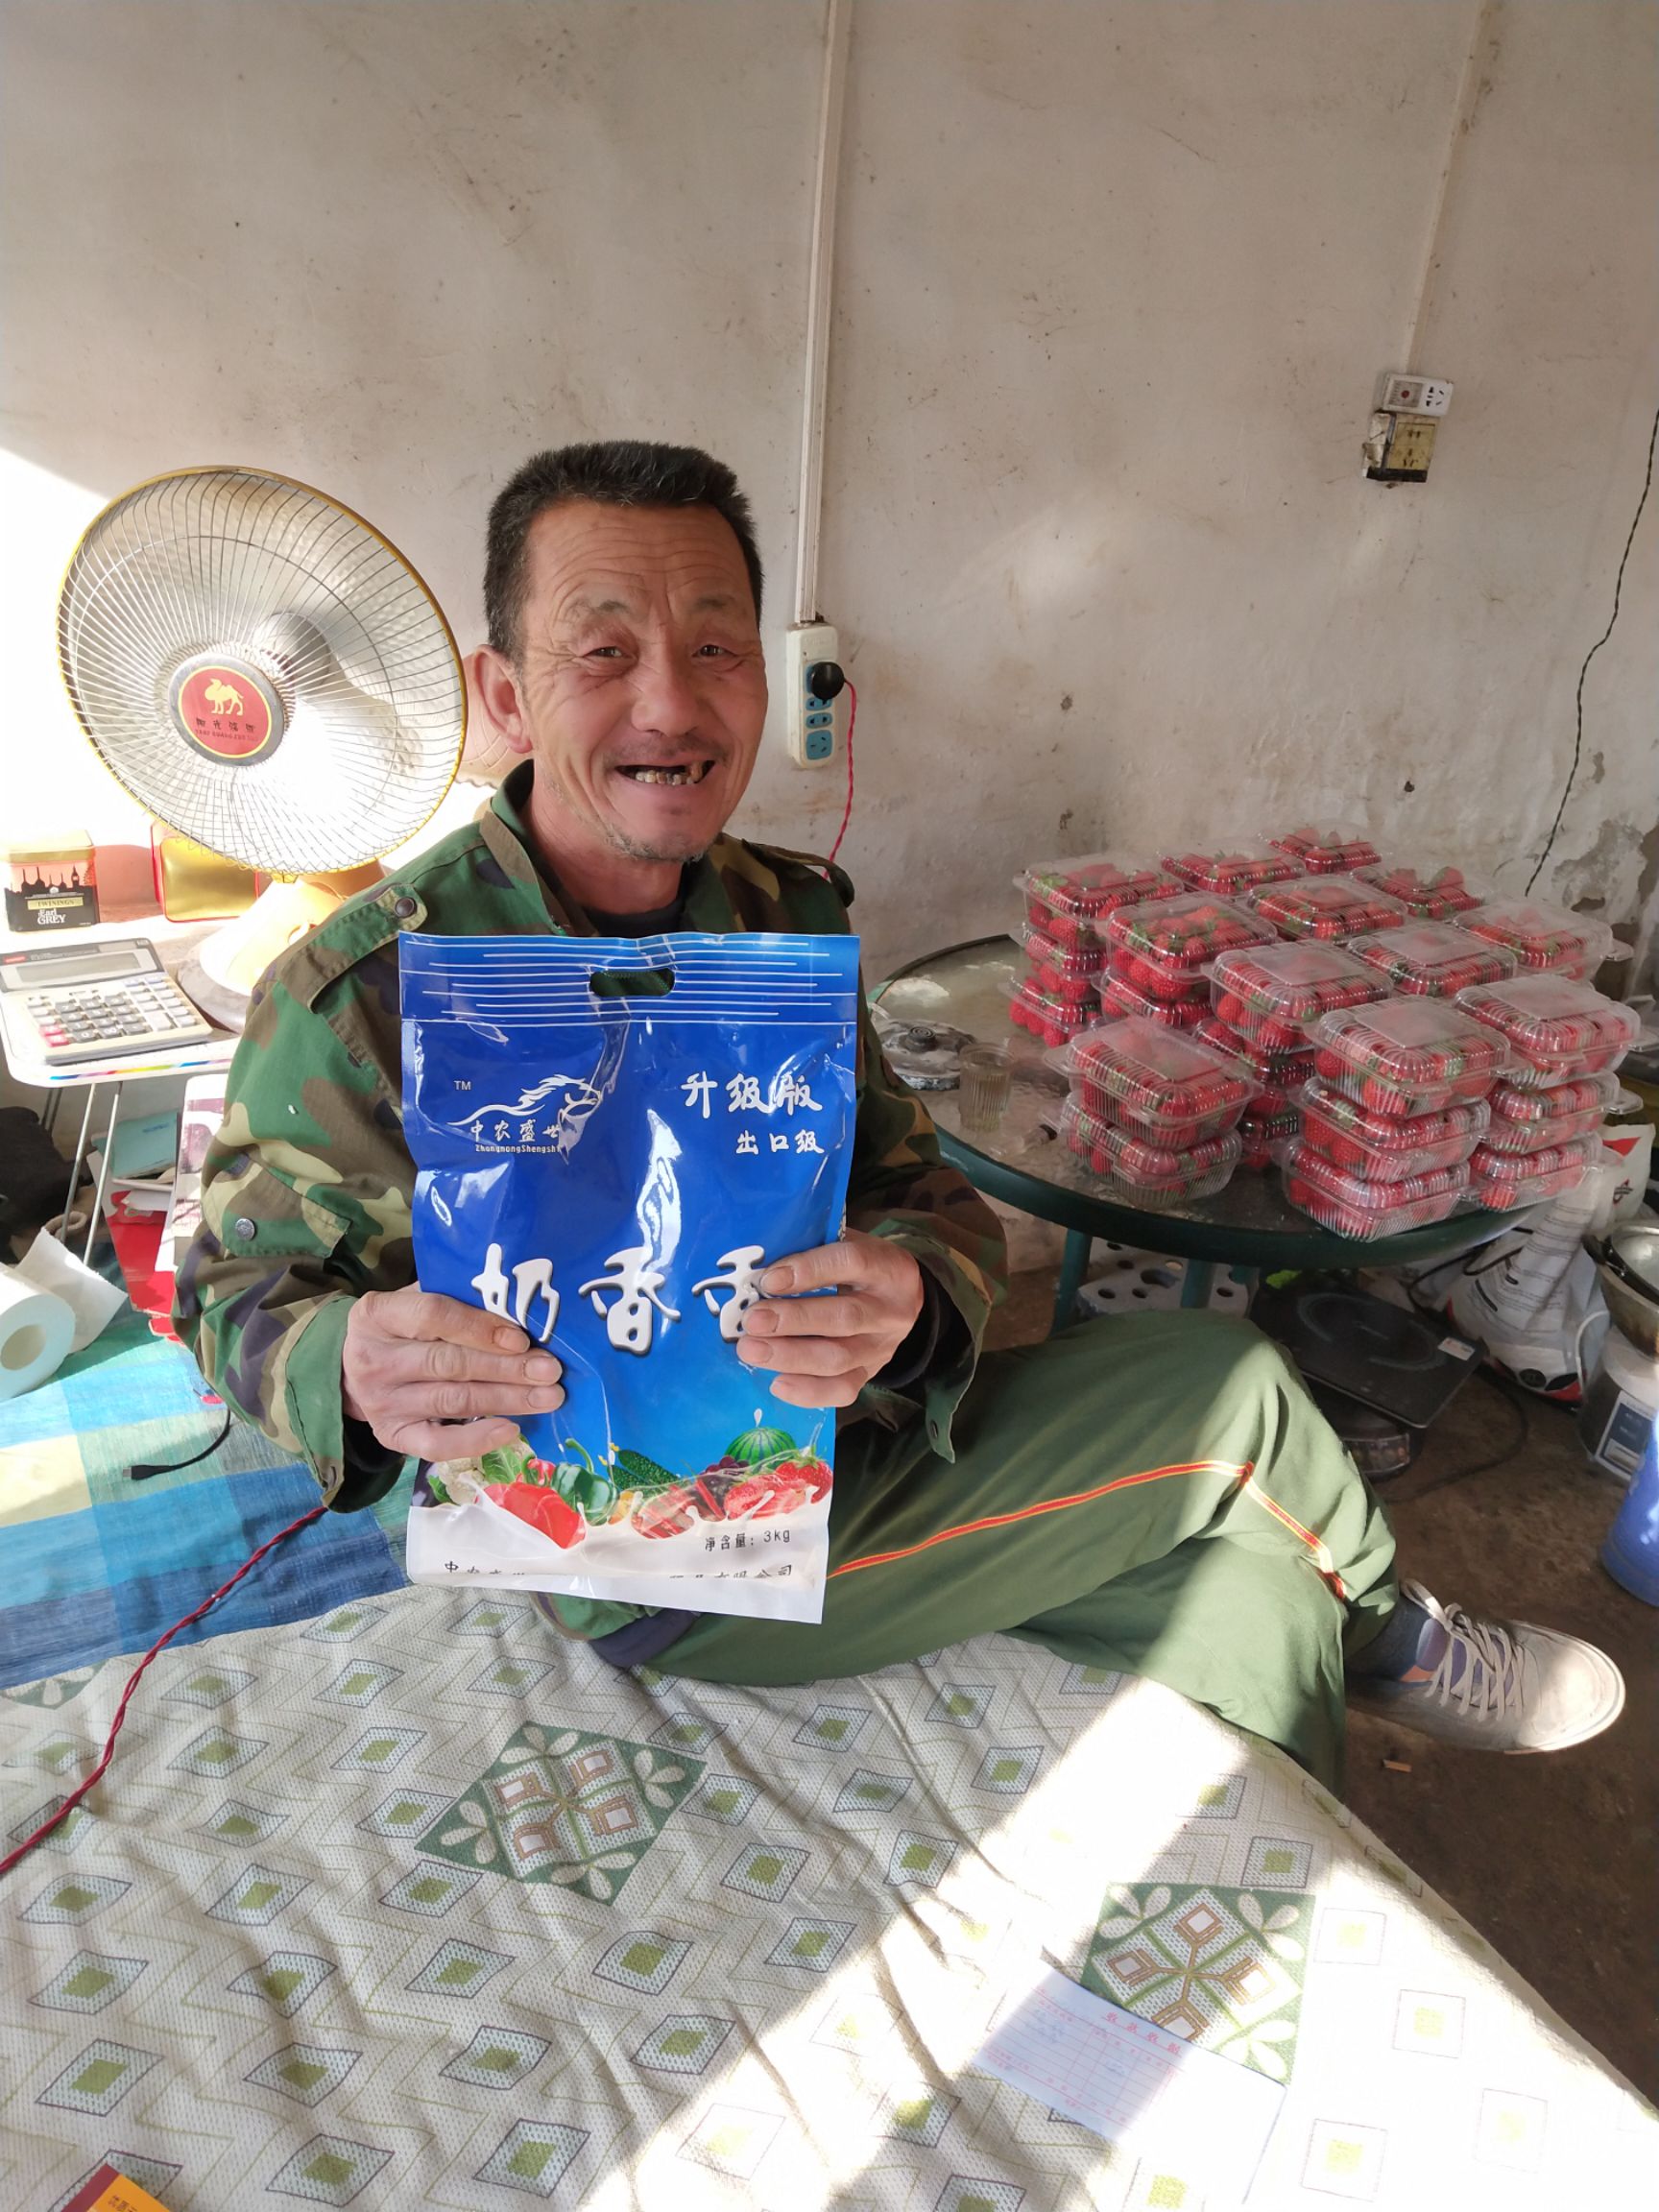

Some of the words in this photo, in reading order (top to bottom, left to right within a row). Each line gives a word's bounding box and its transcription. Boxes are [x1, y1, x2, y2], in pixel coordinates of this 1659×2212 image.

[37, 914, 66, 925] GREY
[453, 1080, 471, 1091] TM
[681, 1070, 823, 1118] 升级版
[470, 1119, 561, 1142] 中农盛世
[735, 1129, 825, 1155] 出口级
[763, 1529, 790, 1543] 3kg
